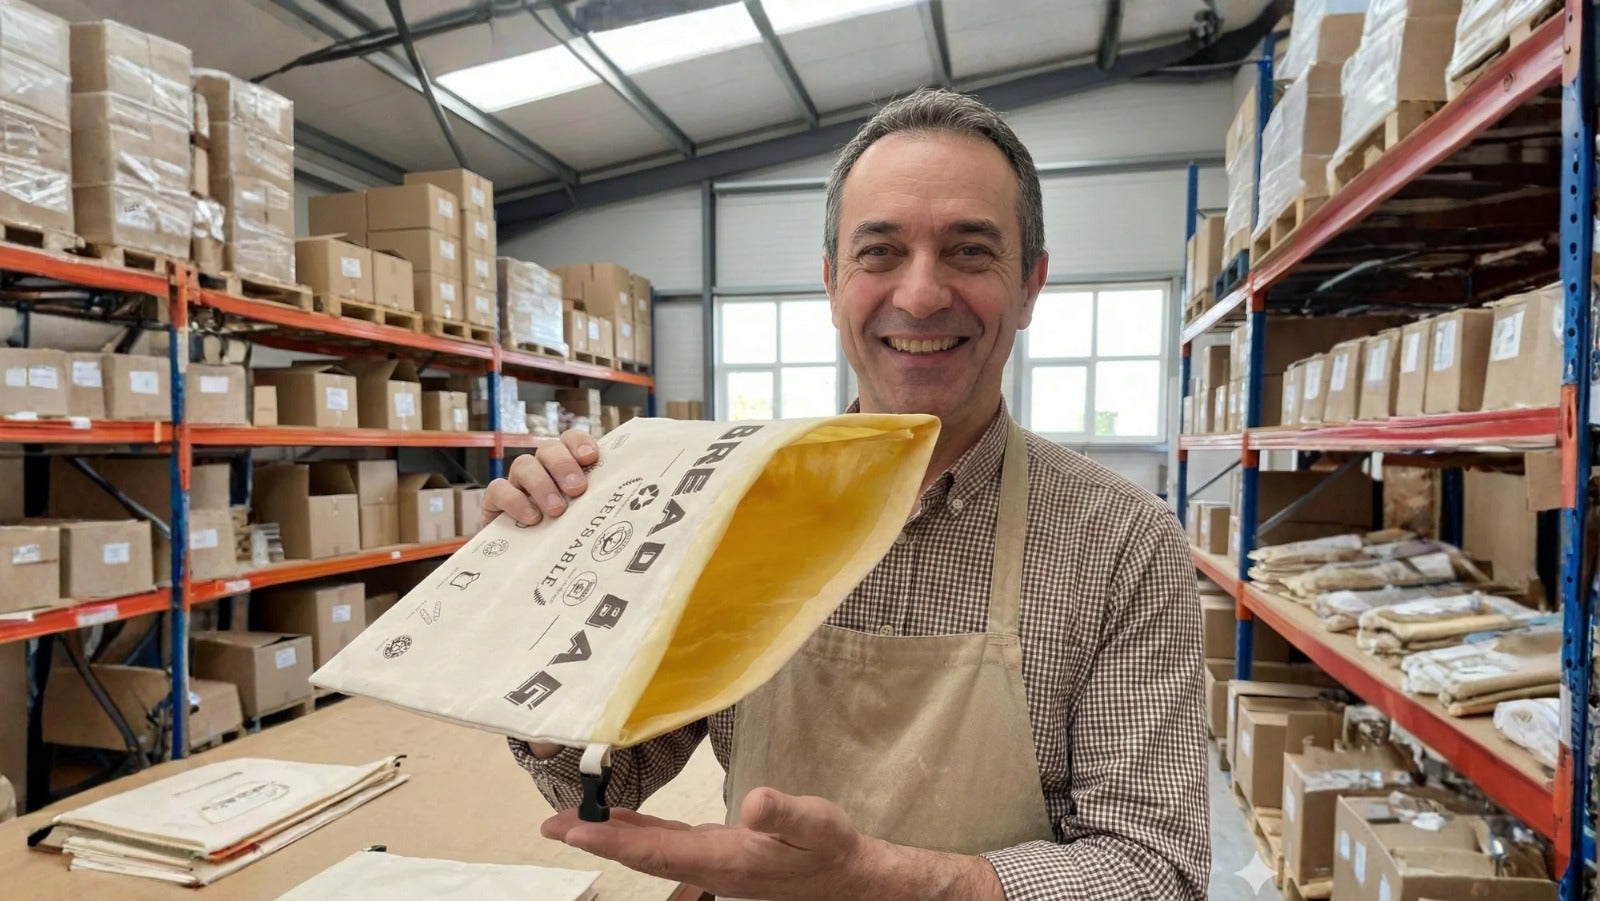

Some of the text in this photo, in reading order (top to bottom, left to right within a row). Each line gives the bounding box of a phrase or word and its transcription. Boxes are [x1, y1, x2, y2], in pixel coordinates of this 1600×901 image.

[504, 425, 765, 711] BREAD BAG
[541, 492, 624, 587] REUSABLE
